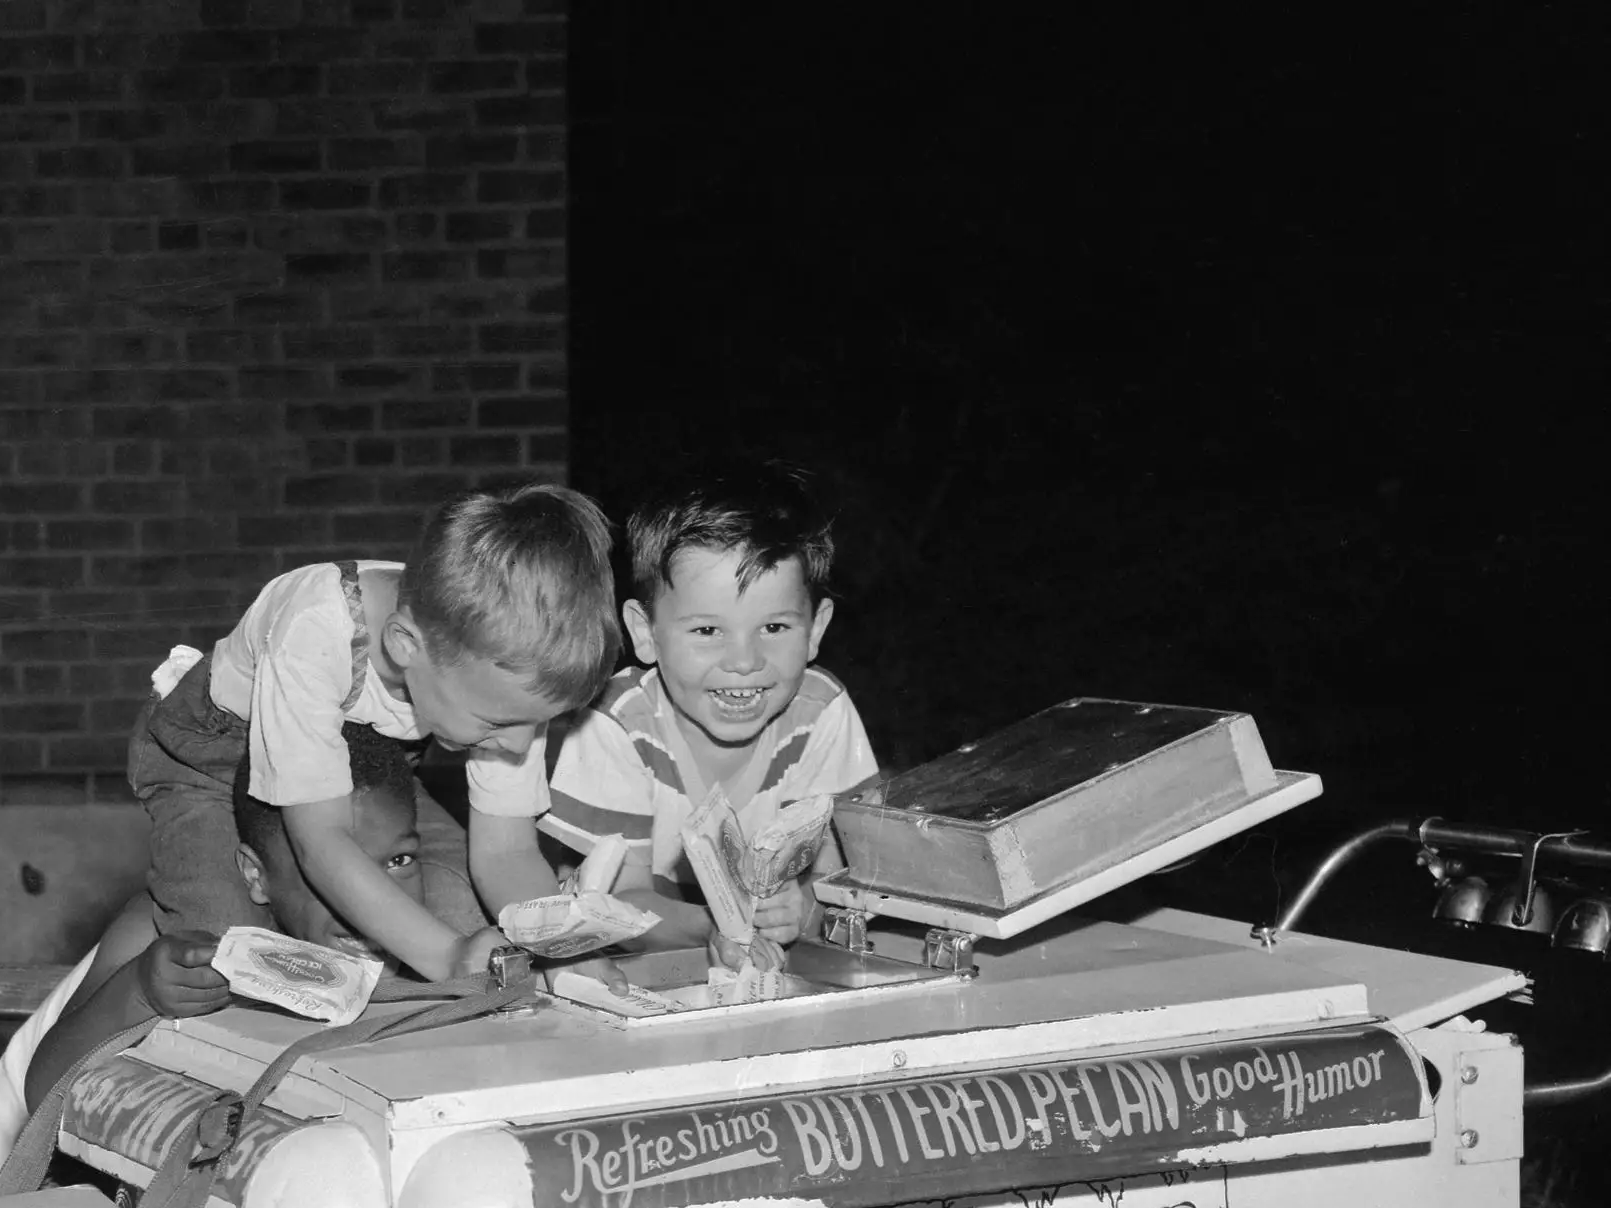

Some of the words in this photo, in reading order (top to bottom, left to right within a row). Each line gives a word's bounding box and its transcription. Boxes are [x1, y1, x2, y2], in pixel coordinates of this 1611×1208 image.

[556, 1107, 780, 1203] Refreshing
[789, 1074, 1033, 1174] BUTTERED
[1033, 1058, 1181, 1146] PECAN
[1183, 1048, 1278, 1110] Good
[1274, 1049, 1385, 1116] Humor
